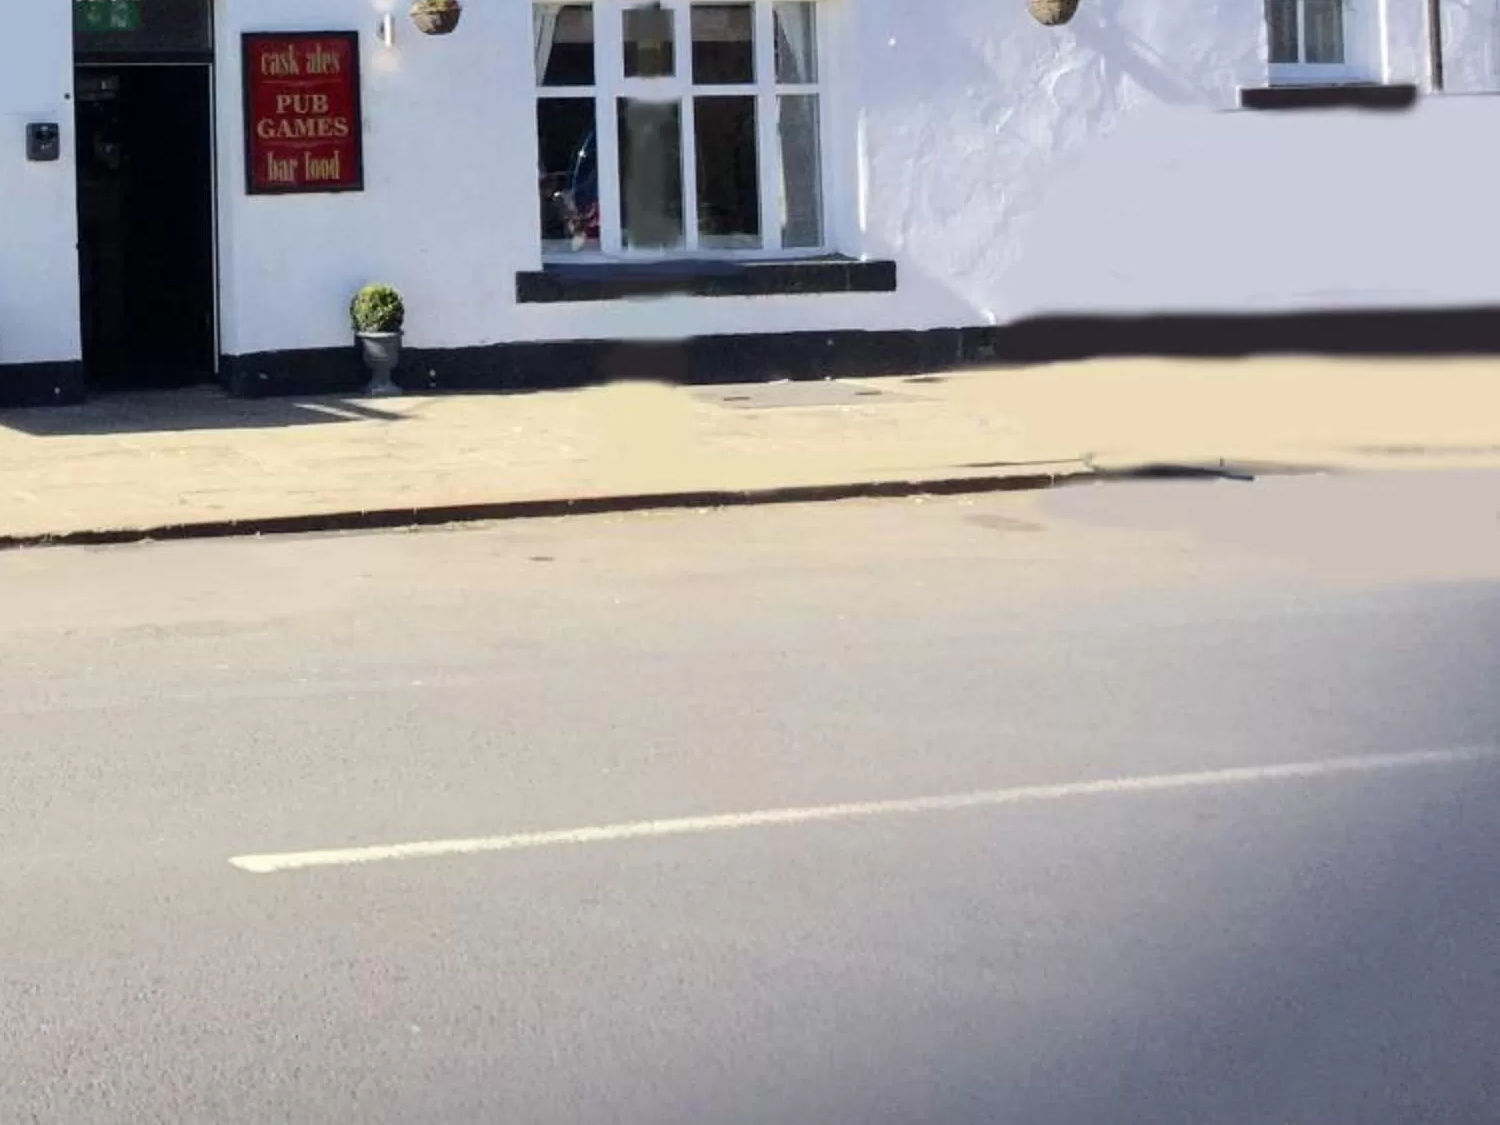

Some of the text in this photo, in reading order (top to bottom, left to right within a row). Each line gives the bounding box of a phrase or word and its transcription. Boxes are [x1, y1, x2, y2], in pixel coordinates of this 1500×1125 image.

[261, 43, 341, 76] cask ales
[275, 94, 329, 114] PUB
[257, 116, 349, 139] GAMES
[267, 150, 340, 182] bar food
